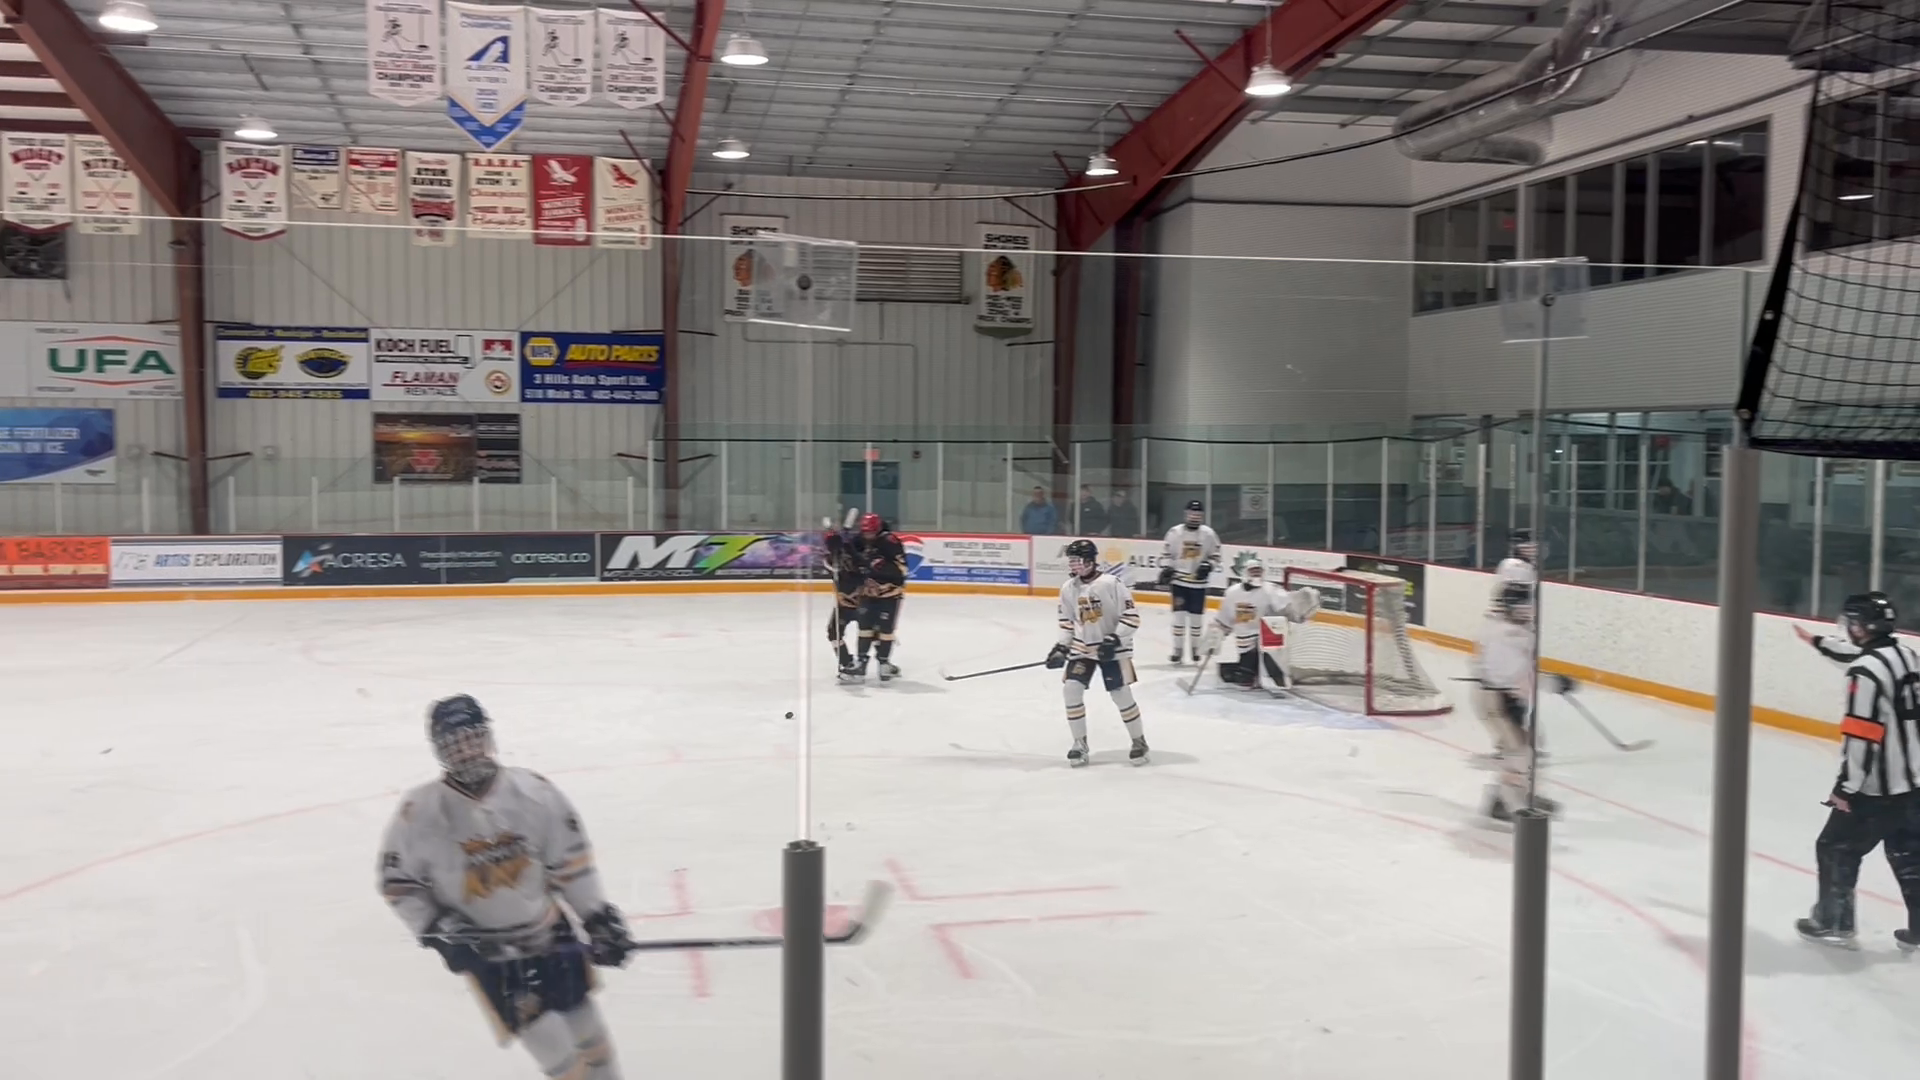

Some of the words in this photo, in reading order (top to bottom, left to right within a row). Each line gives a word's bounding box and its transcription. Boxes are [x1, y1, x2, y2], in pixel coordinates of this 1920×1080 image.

[376, 72, 434, 83] CHAMPIONS
[538, 85, 588, 95] CHAMPIONS
[607, 84, 658, 95] CHAMPIONS
[984, 233, 1030, 246] SHORES
[374, 338, 415, 353] KOCH
[419, 339, 455, 353] FUEL
[565, 344, 609, 361] AUTO
[609, 345, 660, 362] PARTS
[47, 348, 176, 374] UFA
[390, 371, 460, 384] FLAMAN
[533, 374, 542, 384] 3
[543, 374, 570, 384] Hills
[571, 375, 597, 385] Auto
[403, 387, 459, 396] RENTALS
[194, 553, 278, 567] EXPLORATION
[325, 552, 407, 569] ACRESA
[510, 552, 591, 564] acresa.co
